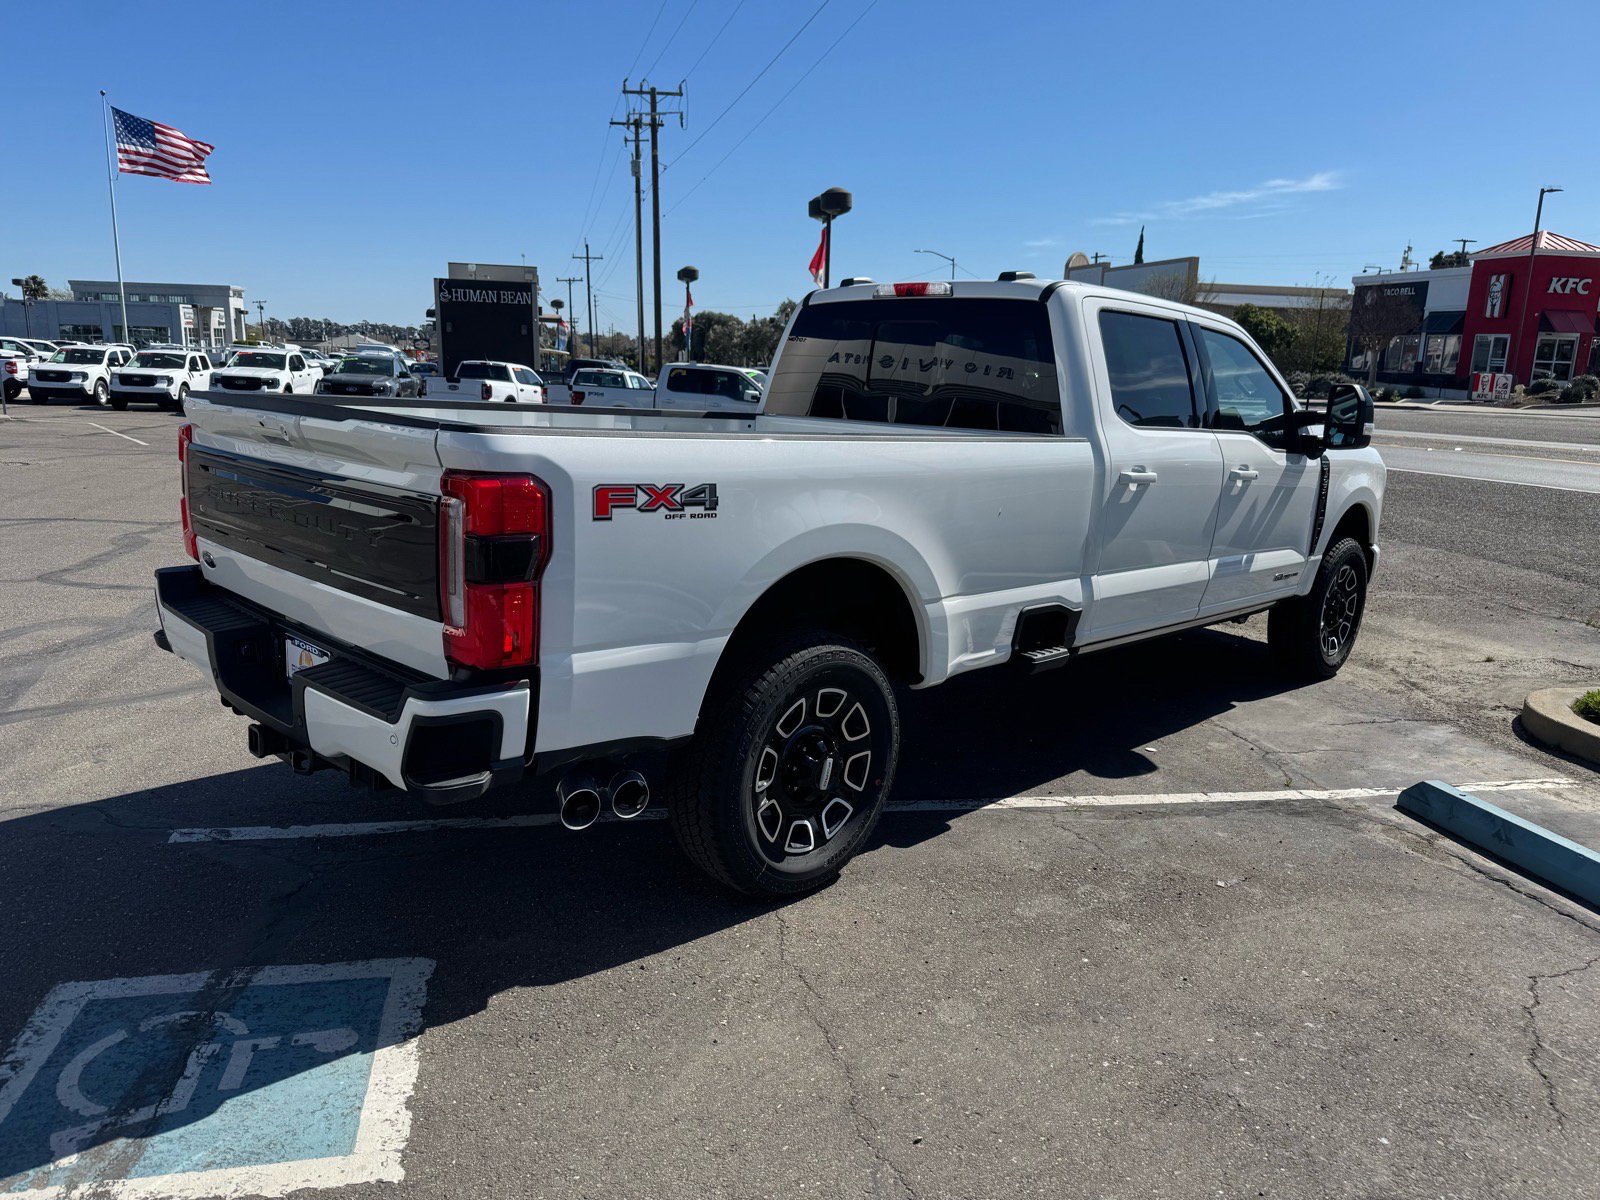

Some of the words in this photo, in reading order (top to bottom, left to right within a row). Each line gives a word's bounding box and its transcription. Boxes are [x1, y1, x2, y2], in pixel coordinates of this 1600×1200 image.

[1383, 288, 1400, 296] TACO
[1400, 287, 1416, 296] BELL
[1547, 277, 1593, 295] KFC
[451, 288, 498, 303] HUMAN
[499, 290, 532, 305] BEAN
[593, 483, 719, 521] FX4
[294, 639, 319, 655] FORD
